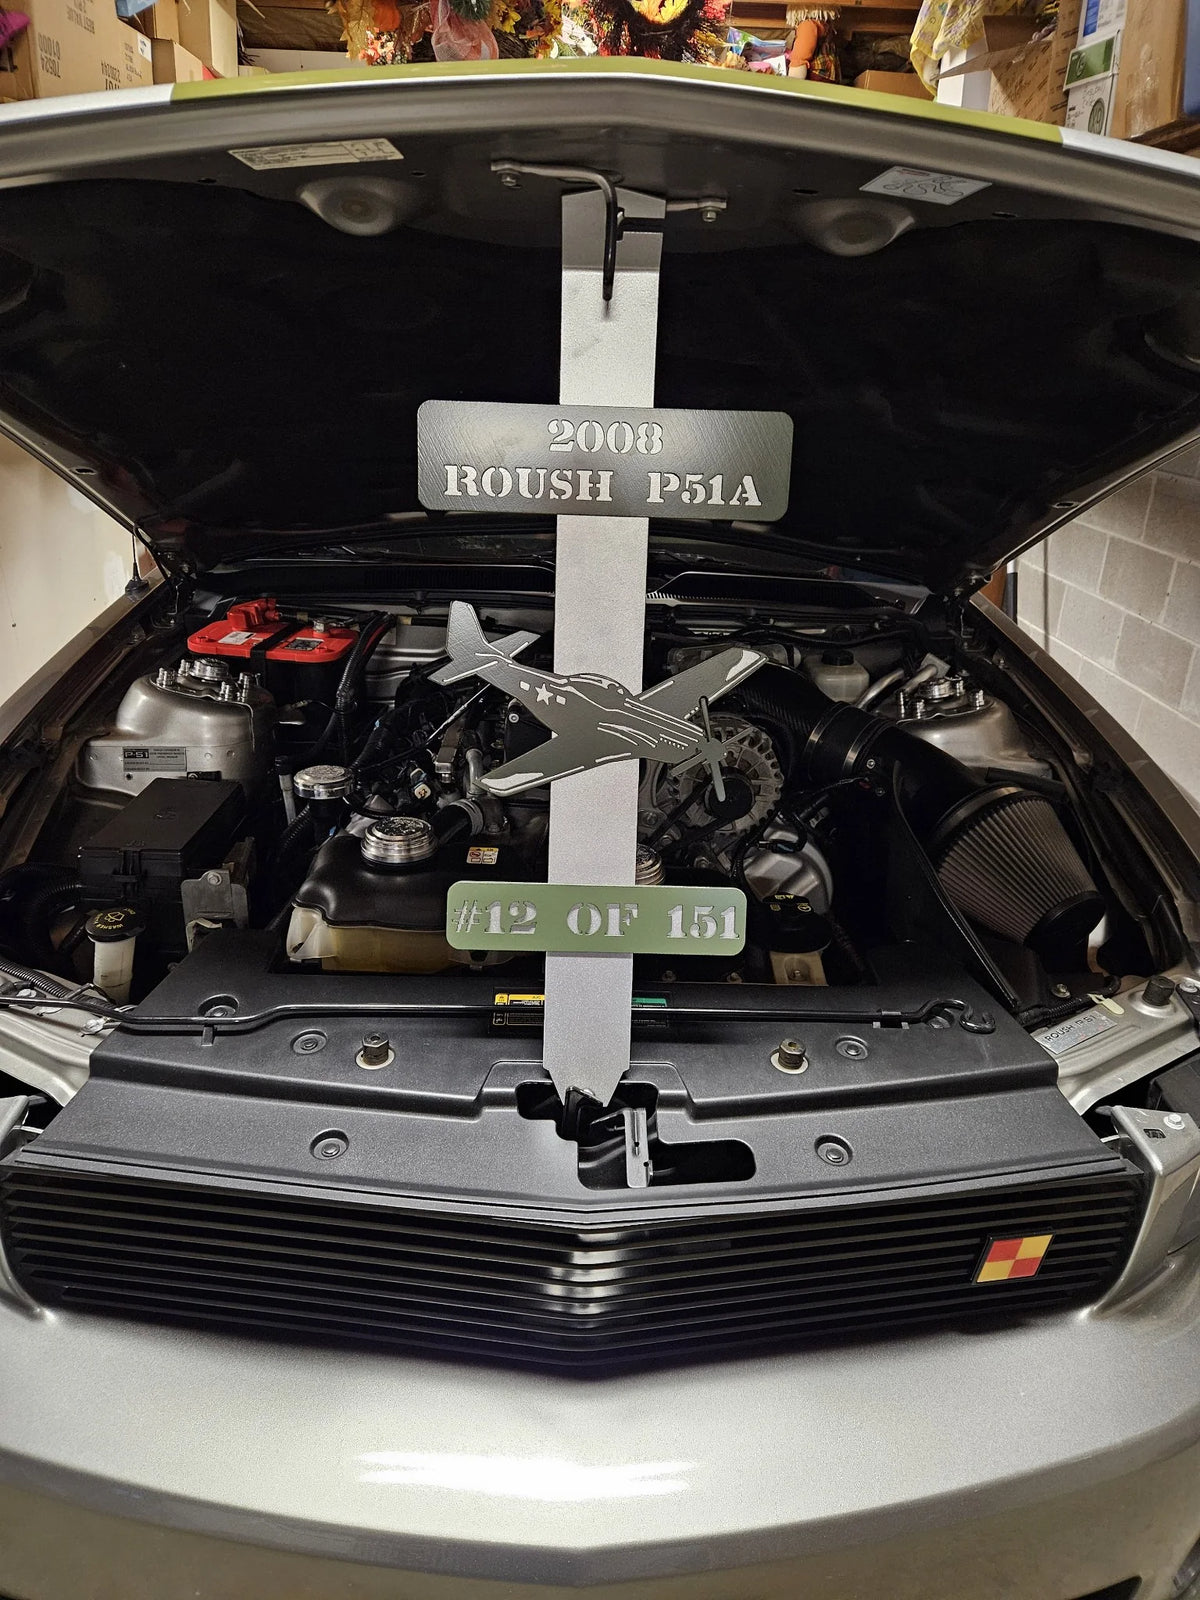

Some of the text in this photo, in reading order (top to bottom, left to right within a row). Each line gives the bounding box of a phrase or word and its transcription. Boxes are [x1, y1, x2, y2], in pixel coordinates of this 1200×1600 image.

[547, 418, 664, 455] 2008
[443, 464, 762, 506] ROUSH P51A
[451, 900, 740, 940] #12 OF 151
[1044, 1025, 1075, 1042] ROUSH
